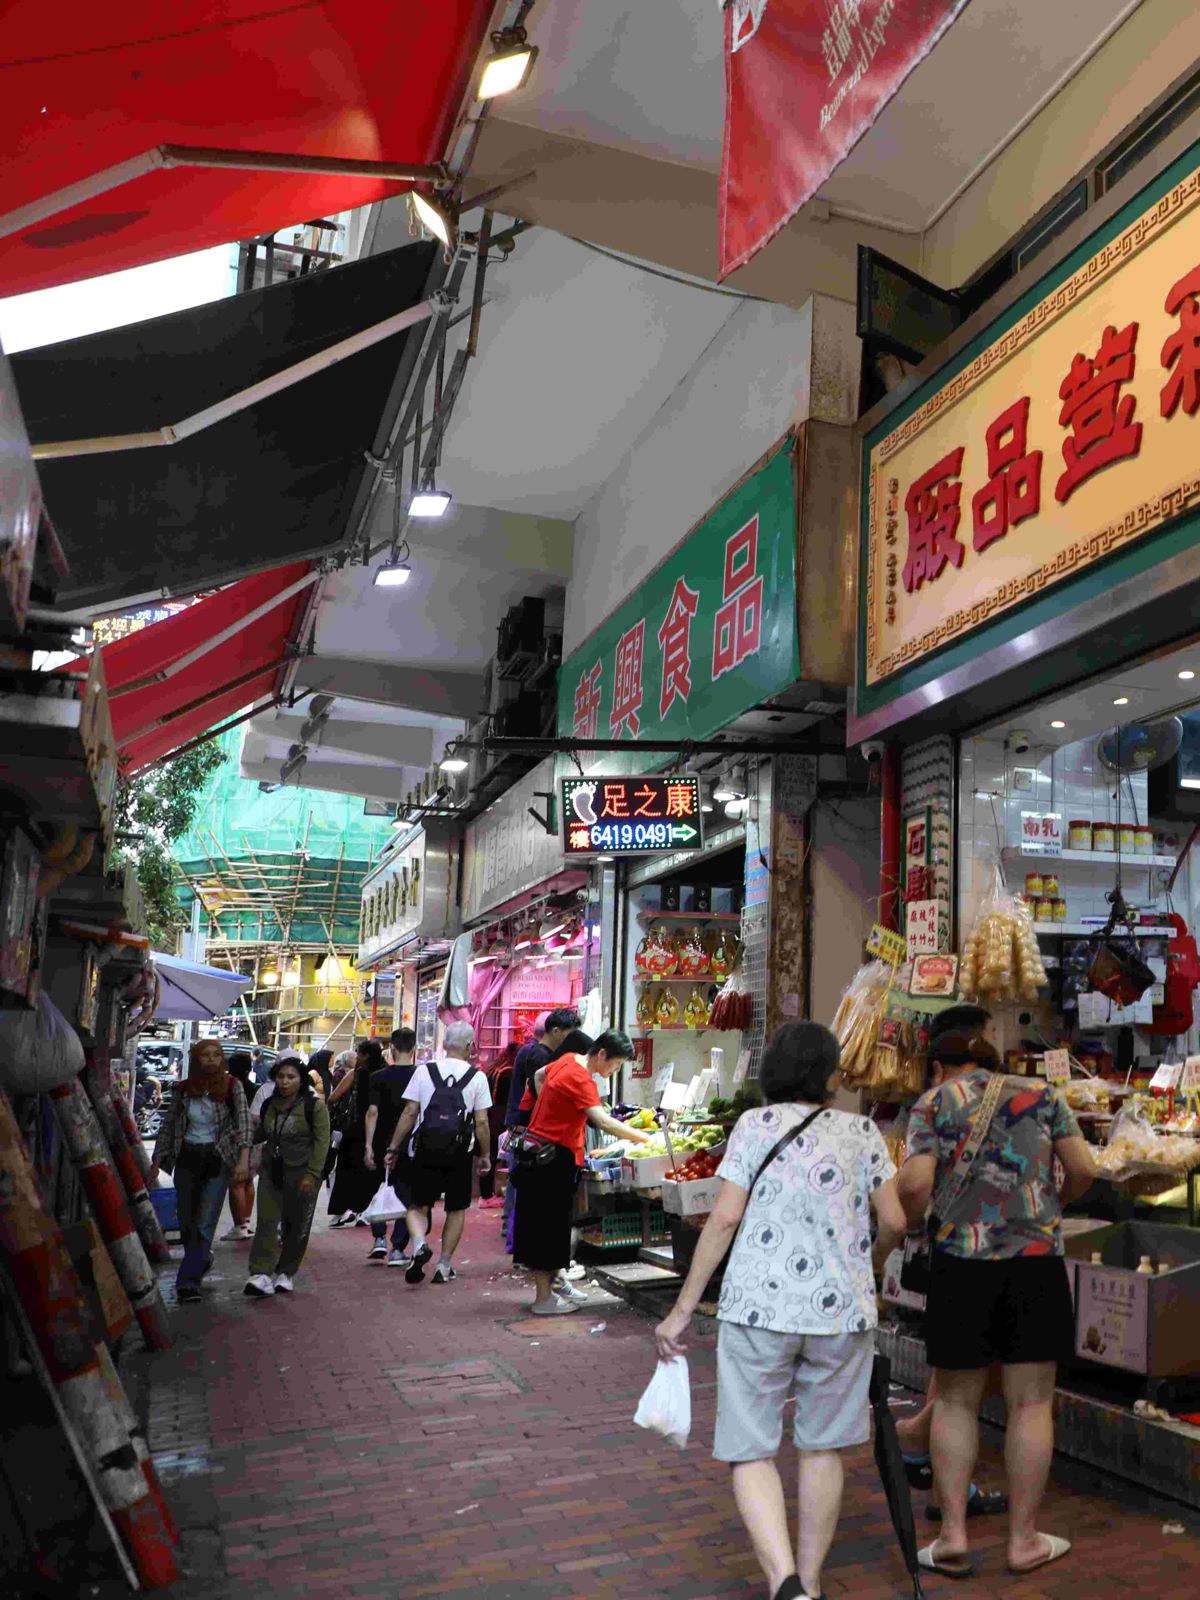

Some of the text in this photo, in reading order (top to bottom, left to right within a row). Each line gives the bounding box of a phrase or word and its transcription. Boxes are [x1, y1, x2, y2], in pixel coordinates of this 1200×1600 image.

[600, 783, 693, 818] 足之康
[590, 822, 674, 846] 6419 0491
[1023, 816, 1060, 838] 南乳
